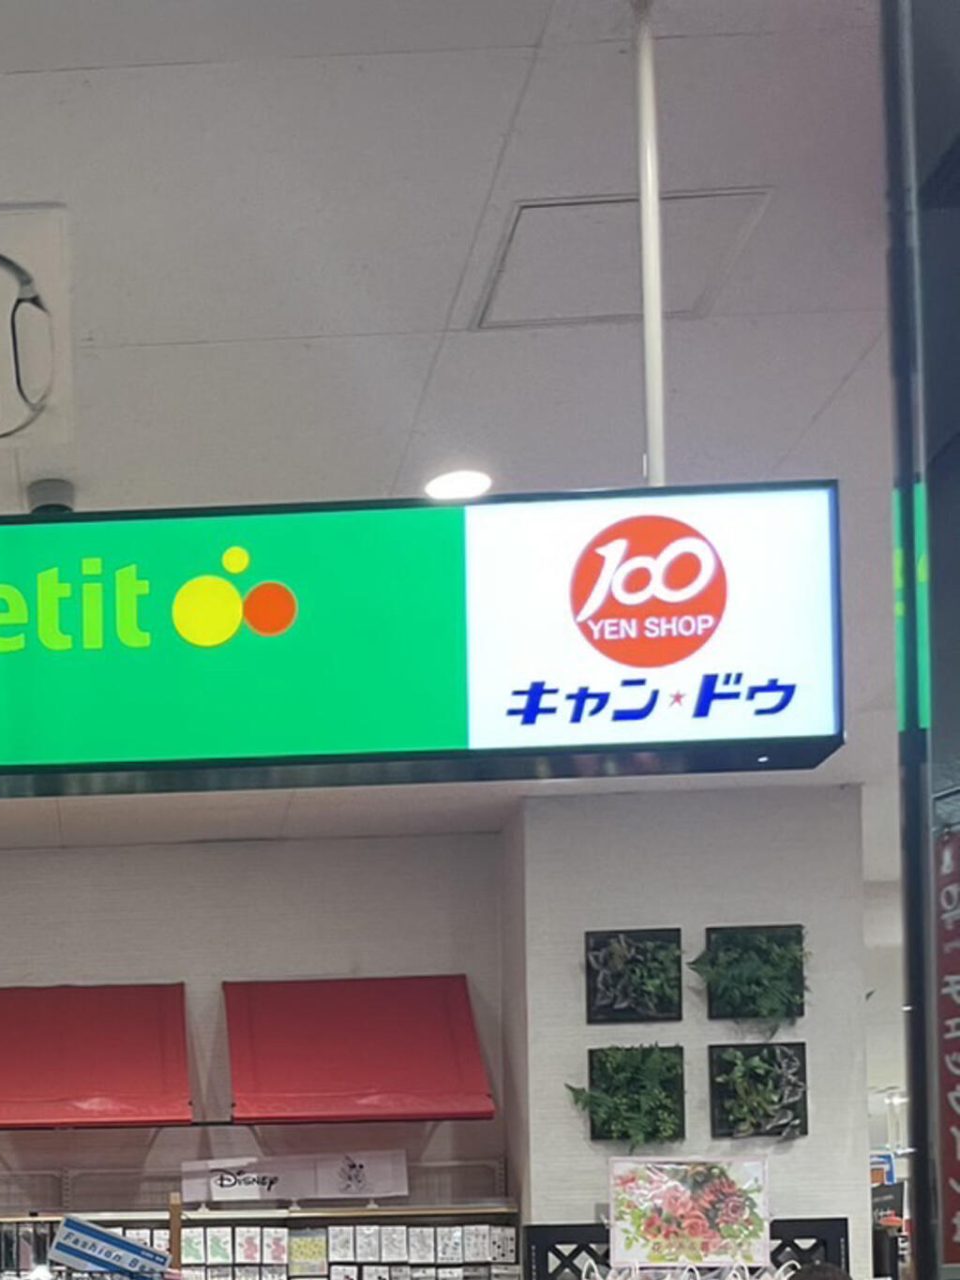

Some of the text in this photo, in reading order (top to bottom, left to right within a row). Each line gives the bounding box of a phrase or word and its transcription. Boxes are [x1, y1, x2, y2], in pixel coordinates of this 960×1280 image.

[576, 536, 717, 623] 100
[587, 614, 714, 640] YEN SHOP
[63, 1231, 123, 1263] Fashion
